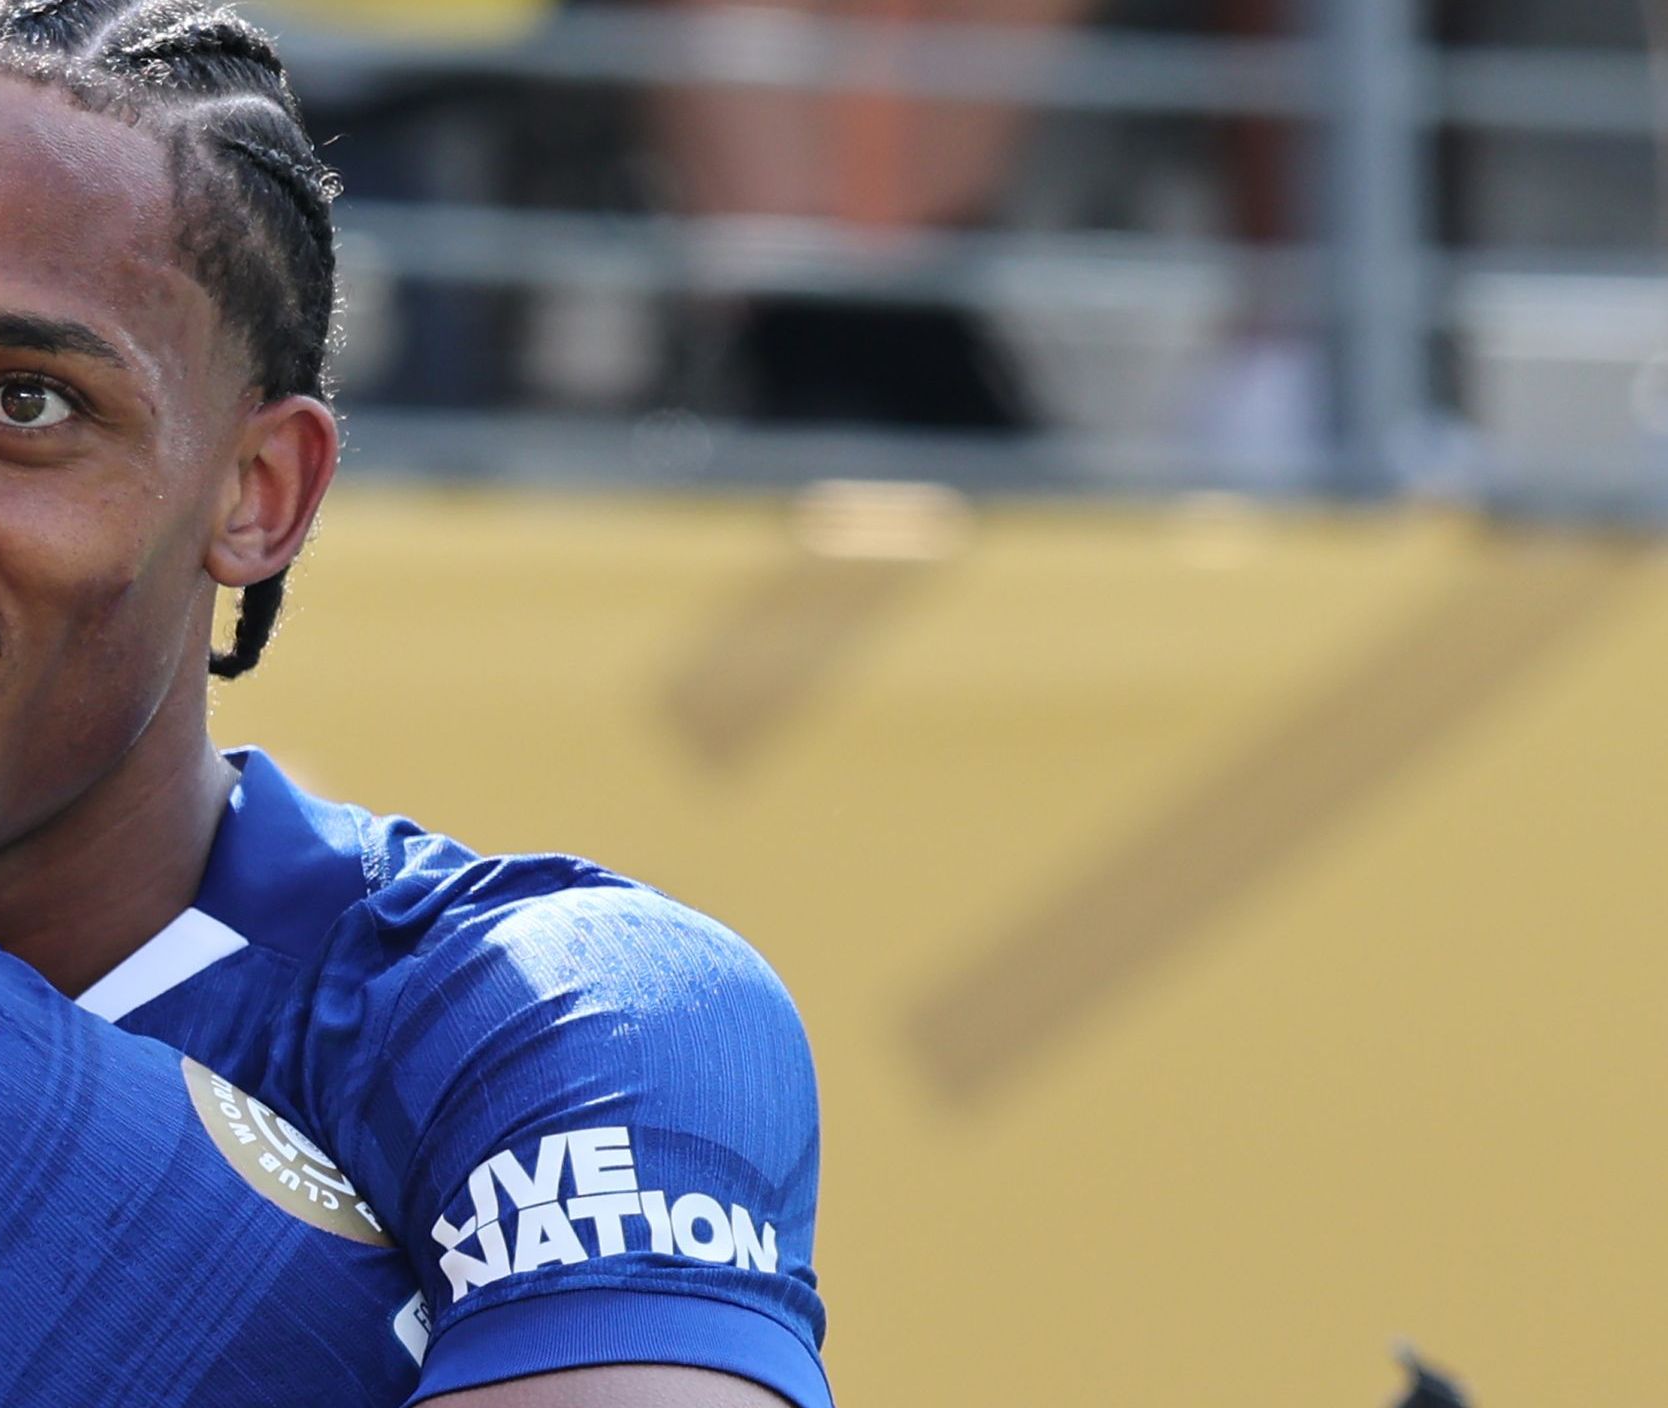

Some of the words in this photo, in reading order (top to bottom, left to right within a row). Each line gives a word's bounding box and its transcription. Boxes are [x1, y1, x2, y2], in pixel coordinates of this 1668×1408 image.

[258, 1152, 340, 1211] CLUB
[431, 1125, 639, 1250] LIVE
[439, 1190, 778, 1303] NATION
